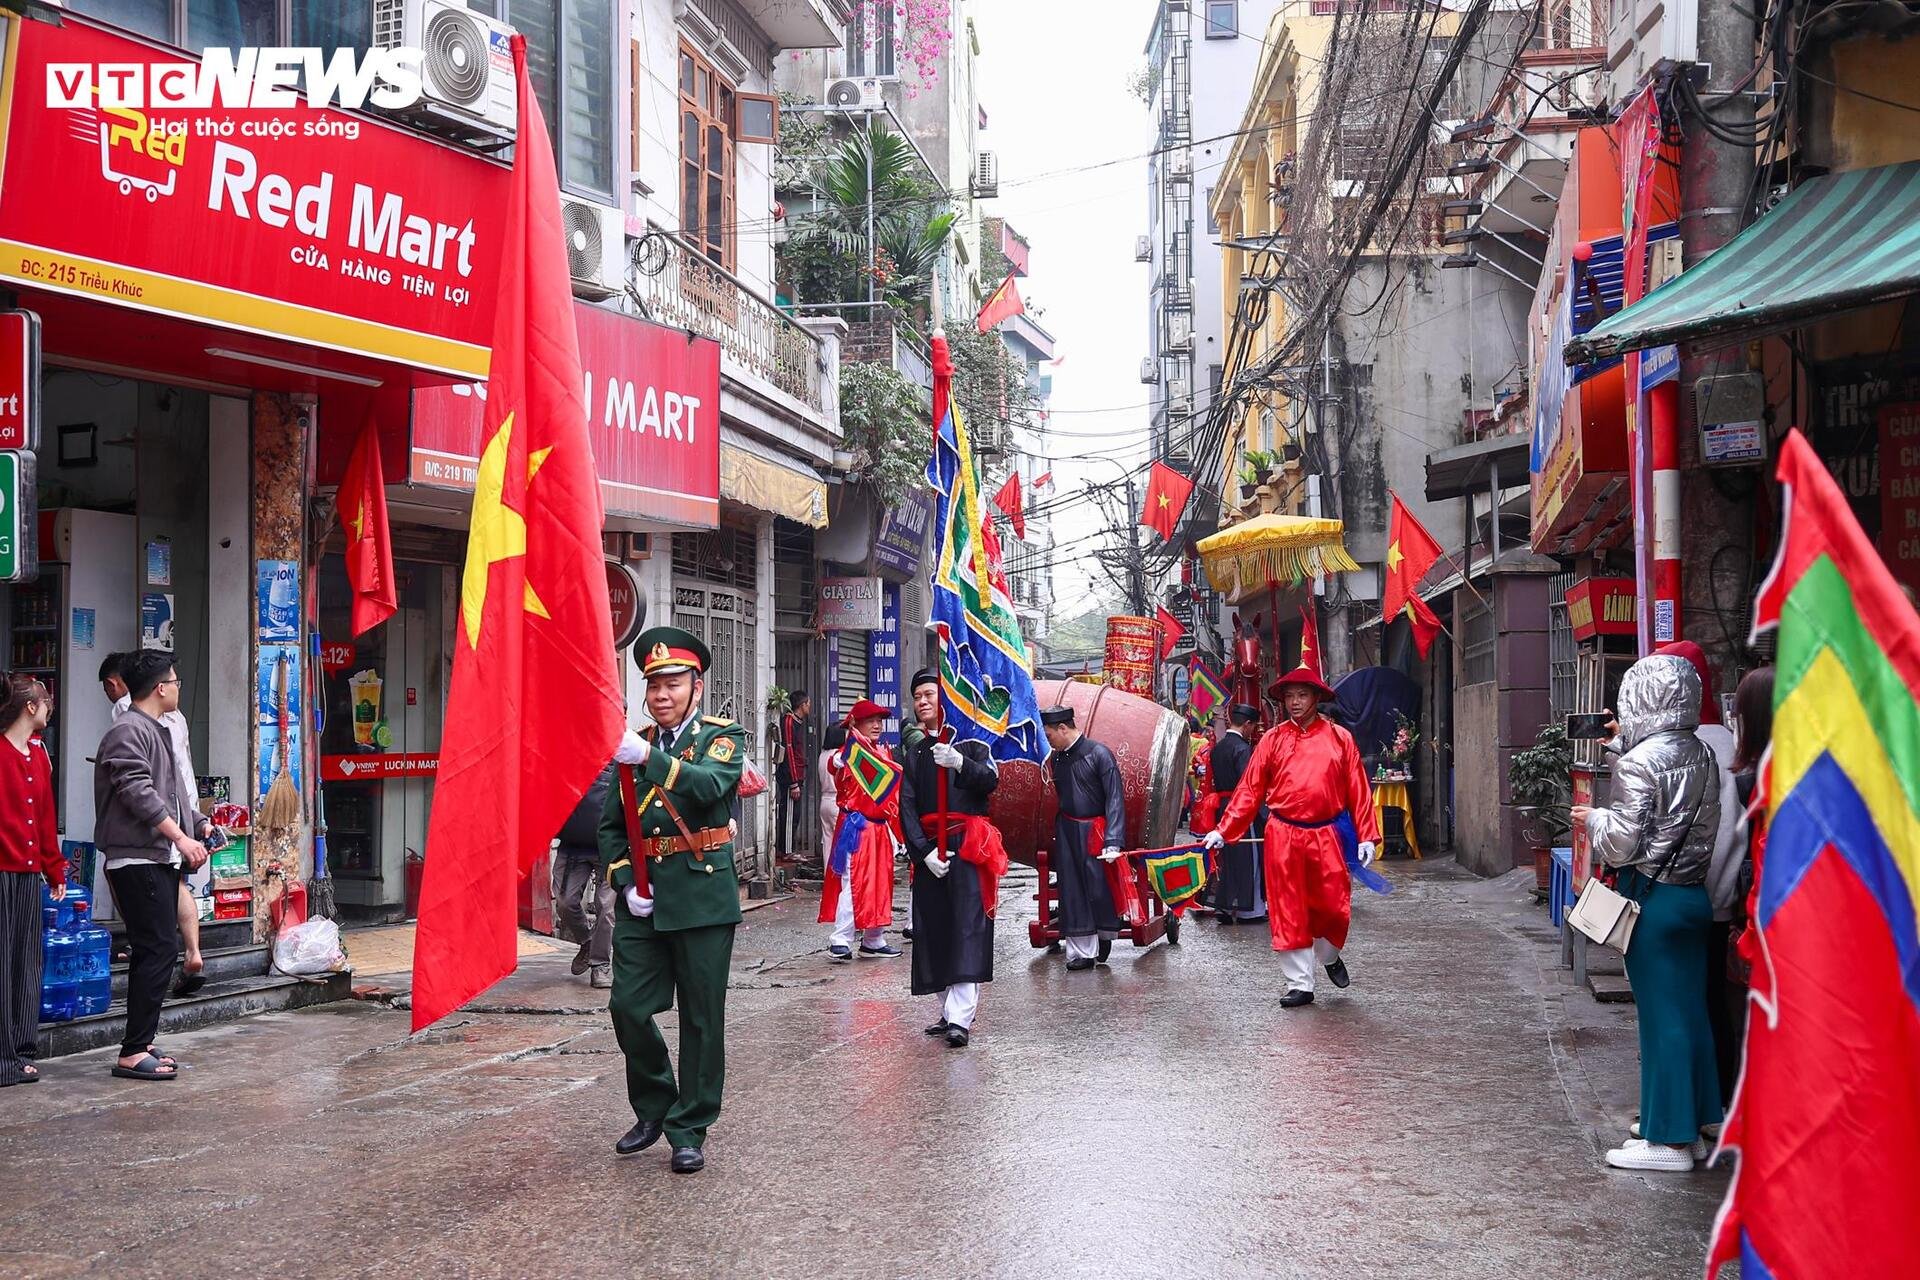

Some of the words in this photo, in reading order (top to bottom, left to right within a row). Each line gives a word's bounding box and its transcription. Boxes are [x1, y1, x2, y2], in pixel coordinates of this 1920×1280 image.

[207, 139, 334, 241] Red
[347, 182, 477, 278] Mart
[20, 258, 46, 278] ĐC:
[48, 262, 77, 284] 215
[79, 272, 109, 291] Triều
[112, 279, 143, 298] Khúc
[289, 245, 330, 271] CỬA
[340, 258, 392, 286] HÀNG
[401, 273, 435, 298] TIỆN
[444, 285, 470, 306] LỢI
[0, 393, 18, 417] rt
[604, 376, 701, 444] MART
[444, 465, 461, 481] 219
[462, 467, 479, 483] TRI
[276, 568, 295, 581] ION
[844, 602, 855, 610] &
[1603, 587, 1633, 622] BÁNH
[384, 760, 415, 770] LUCKIN
[417, 759, 440, 770] MART
[69, 847, 82, 885] aVie
